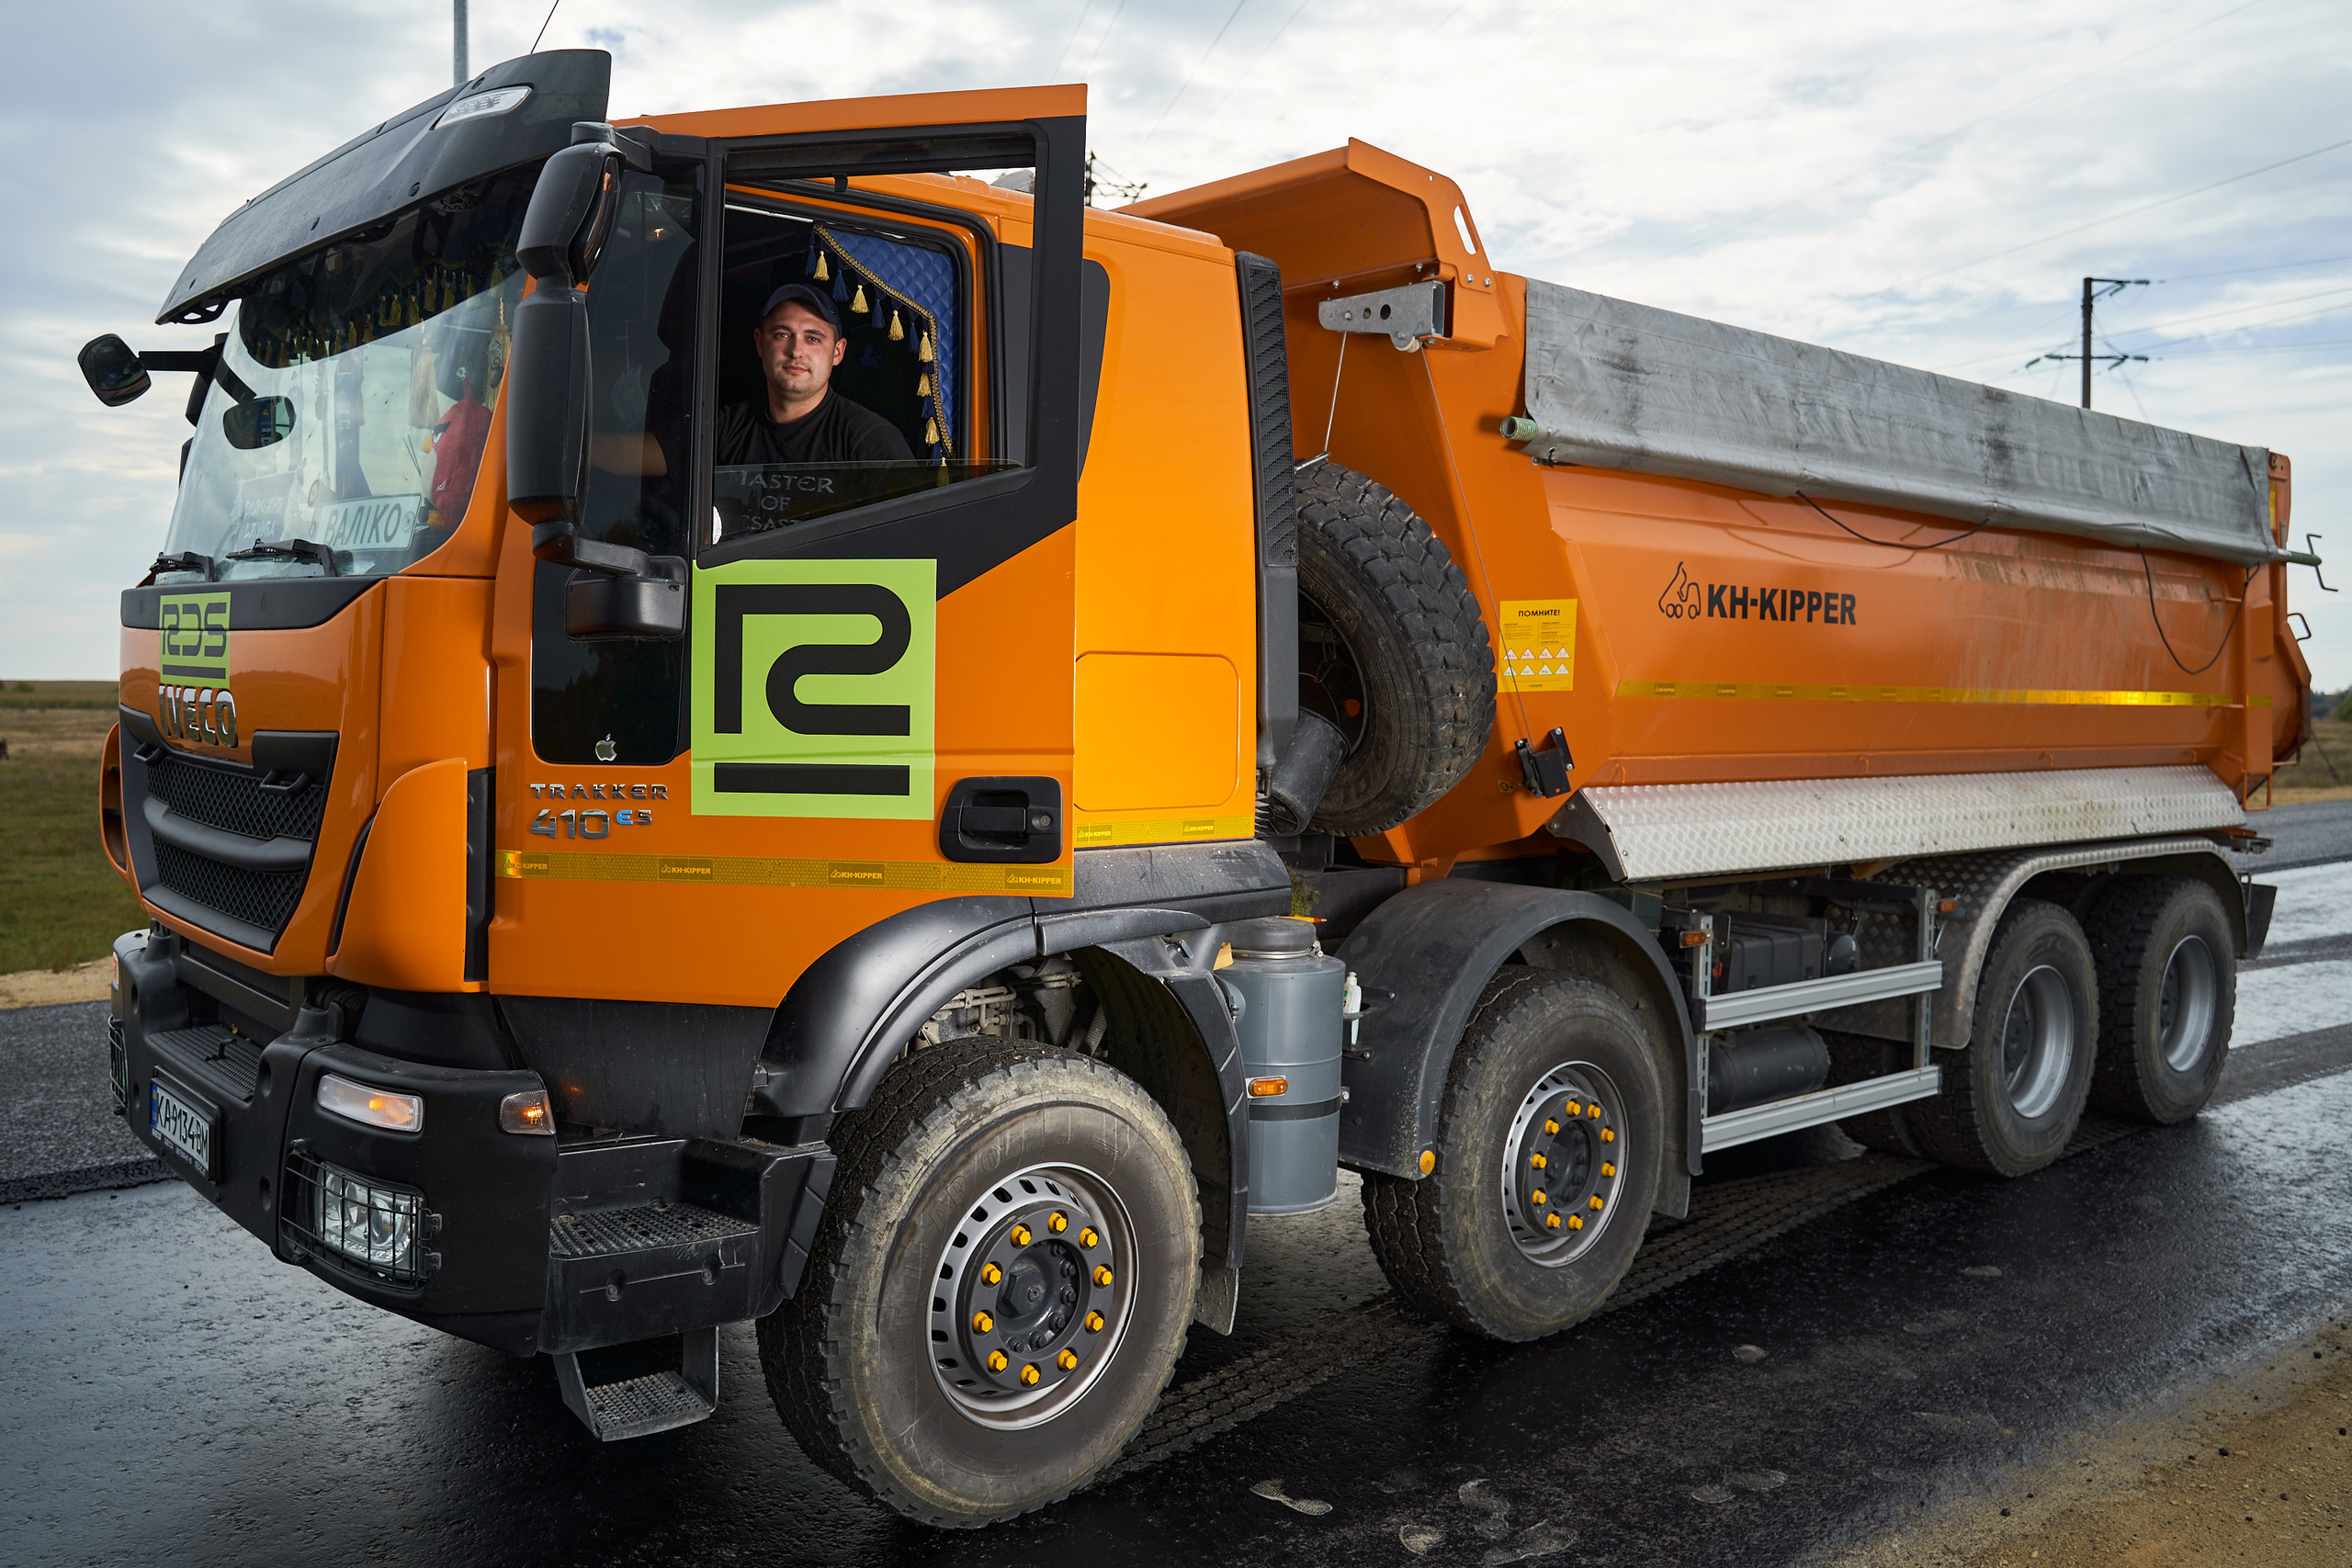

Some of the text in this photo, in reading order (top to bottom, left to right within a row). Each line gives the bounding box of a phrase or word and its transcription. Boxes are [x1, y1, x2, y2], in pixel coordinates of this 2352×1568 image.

[760, 495, 791, 512] OF
[323, 502, 402, 547] ВАЛІКО
[1518, 609, 1561, 617] ПОМНИТЕ!
[1707, 583, 1857, 626] KH-KIPPER
[162, 602, 228, 659] RDS
[158, 683, 239, 749] IVECO
[529, 783, 669, 800] TRAKKER
[530, 808, 611, 840] 410
[672, 866, 712, 874] KH-KIPPER
[841, 871, 883, 880] KH-KIPPER
[1018, 876, 1062, 885] KH-KIPPER
